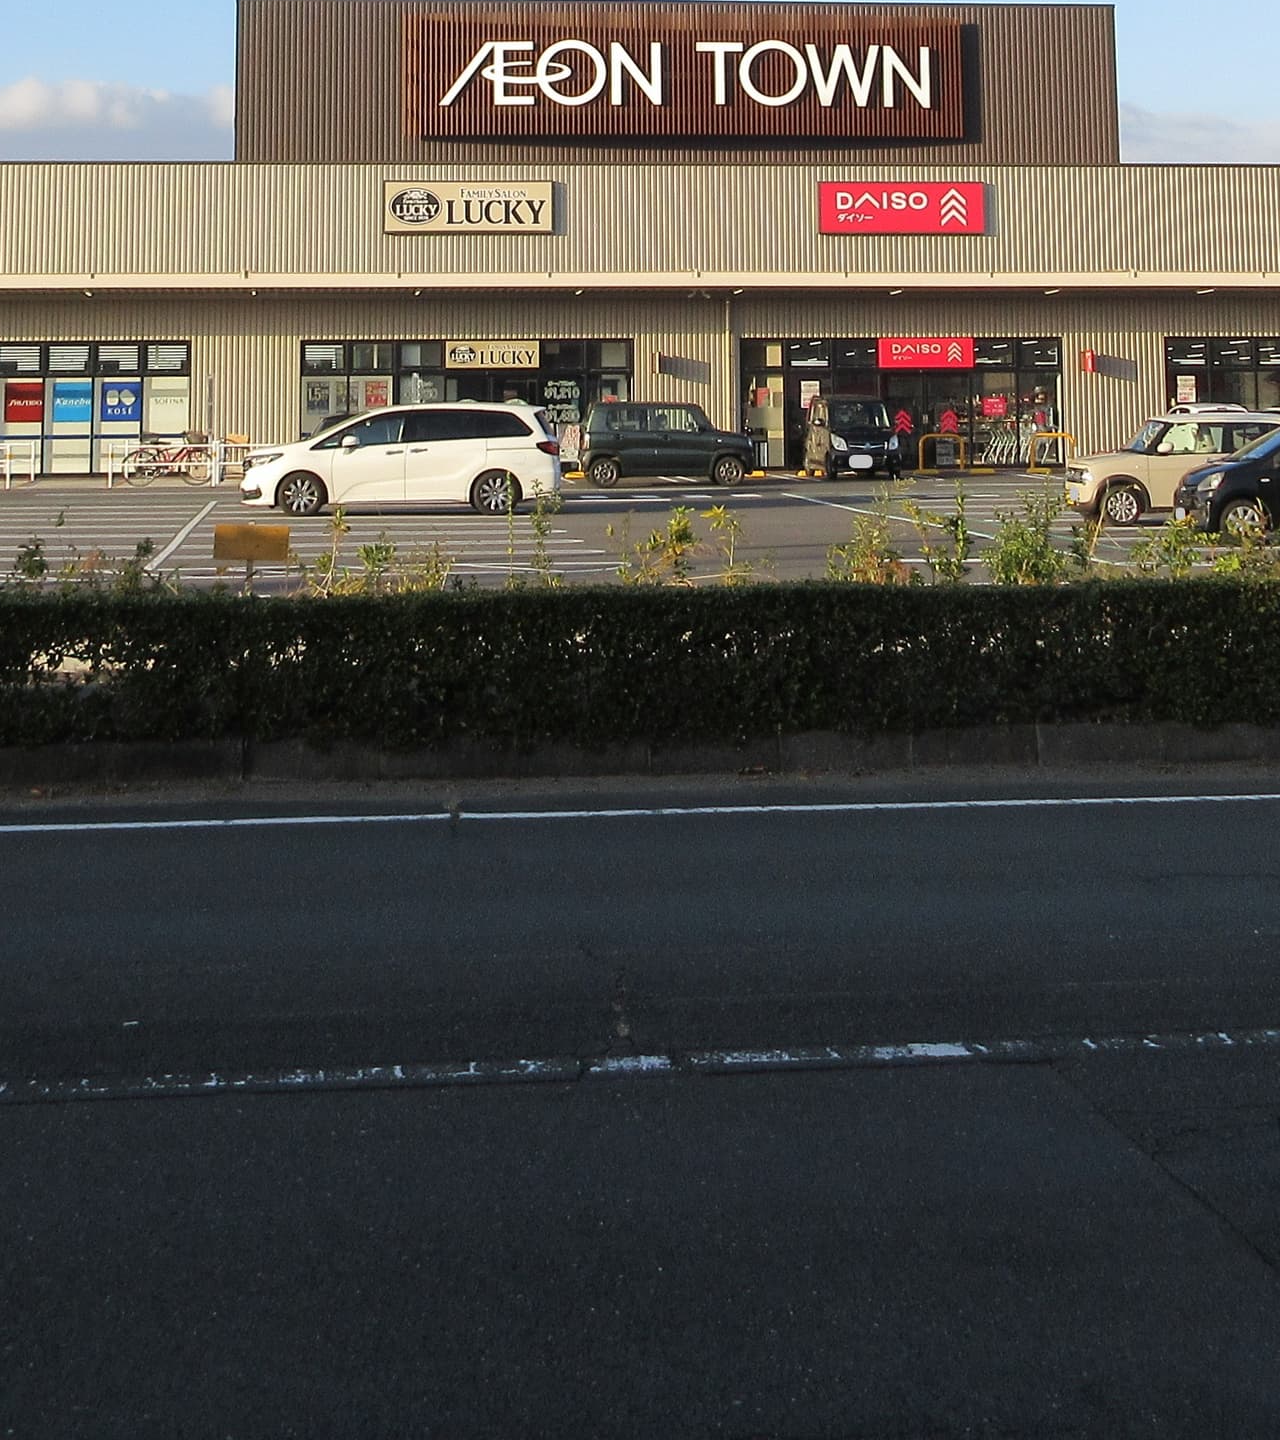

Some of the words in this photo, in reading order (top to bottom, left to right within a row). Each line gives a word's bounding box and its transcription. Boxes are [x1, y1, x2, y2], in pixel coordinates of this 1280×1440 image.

[696, 39, 931, 109] TOWN
[836, 191, 928, 210] DAISO
[396, 204, 438, 216] LUCKY
[446, 200, 546, 225] LUCKY
[837, 213, 873, 223] ダイソー
[891, 344, 941, 354] DAISO
[480, 350, 536, 365] LUCKY
